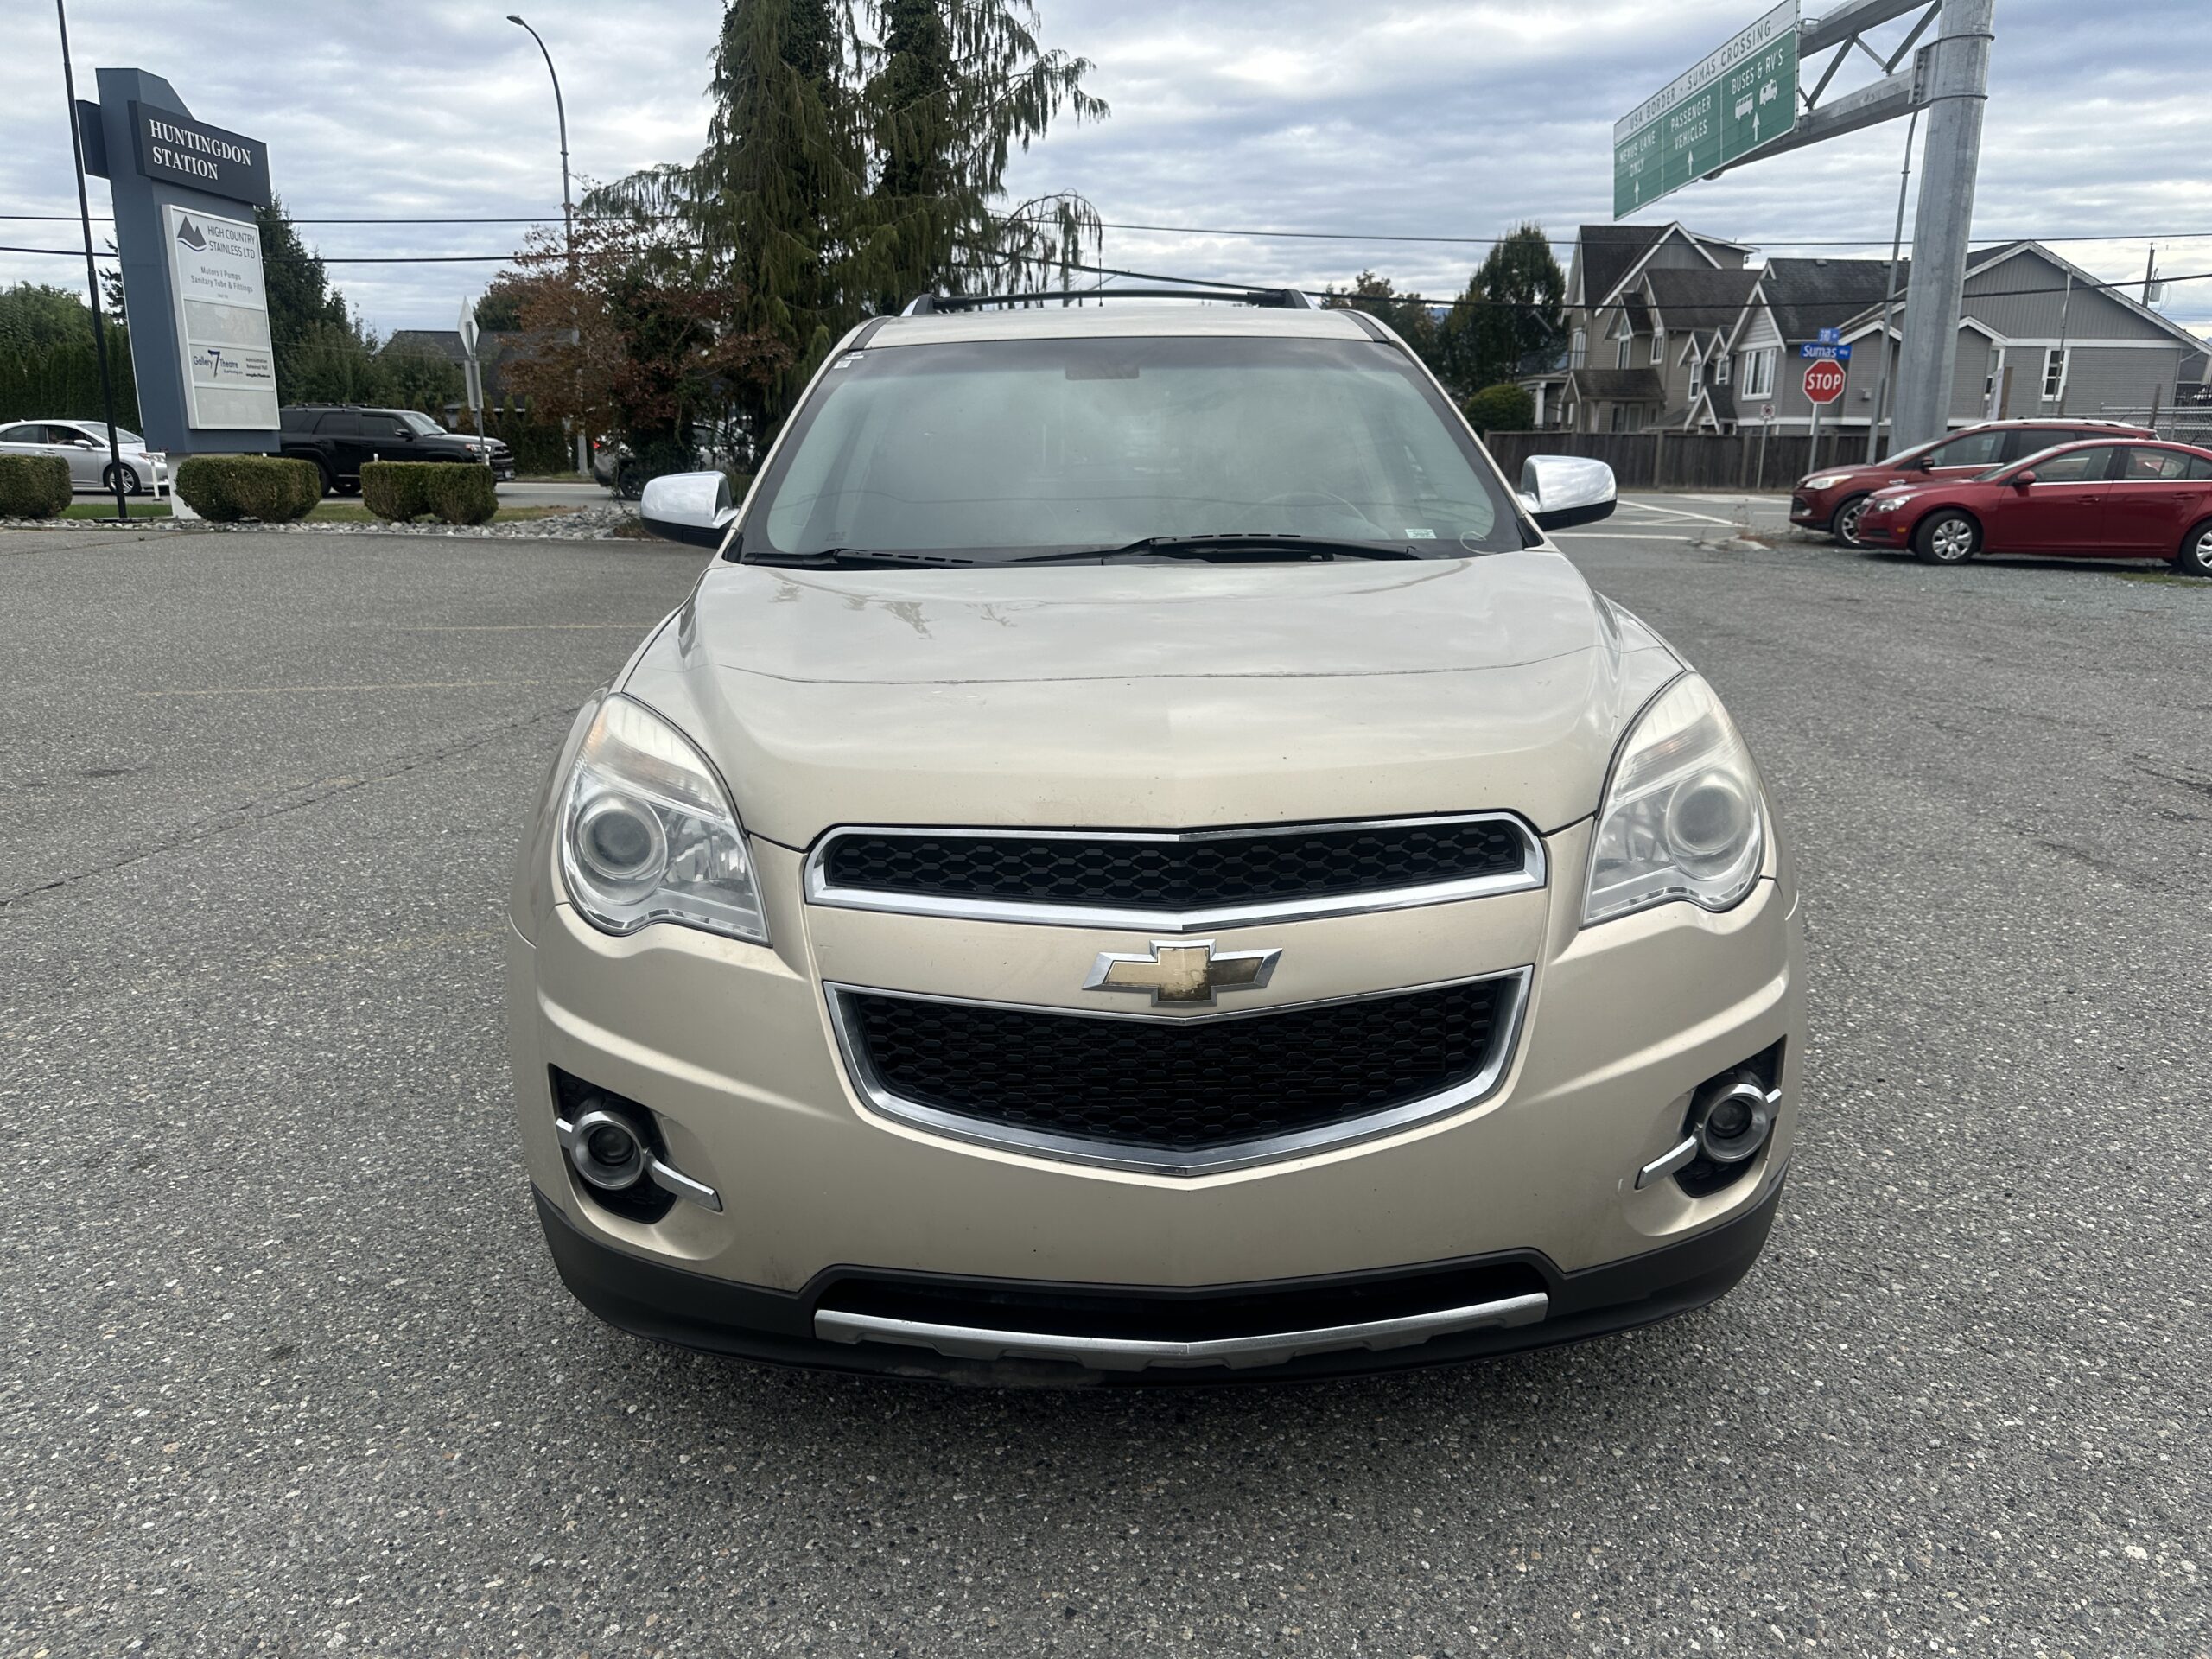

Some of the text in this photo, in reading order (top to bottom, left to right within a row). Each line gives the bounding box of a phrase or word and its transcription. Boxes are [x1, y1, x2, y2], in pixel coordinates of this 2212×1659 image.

[1630, 111, 1643, 130] USA
[1646, 87, 1676, 119] BORDER
[1688, 58, 1716, 91] SUMAS
[1720, 20, 1770, 67] CROSSING
[1732, 48, 1783, 95] BUSES & RV'S
[1670, 94, 1712, 133] PASSENGER
[149, 118, 251, 166] HUNTINGDON
[1640, 130, 1656, 152] LANE
[1675, 118, 1707, 151] VEHICLES
[152, 145, 219, 180] STATION
[207, 225, 256, 245] HIGH COUNTRY
[209, 240, 256, 259] STAINLESS LTD
[190, 275, 253, 294] Sanitary Tube & Fittings
[200, 266, 219, 276] Motors
[224, 270, 241, 281] Pumps
[193, 355, 213, 369] Gallery
[207, 349, 221, 378] 7
[219, 358, 238, 369] Theatre
[1802, 345, 1837, 358] Sumas
[1807, 373, 1842, 391] STOP
